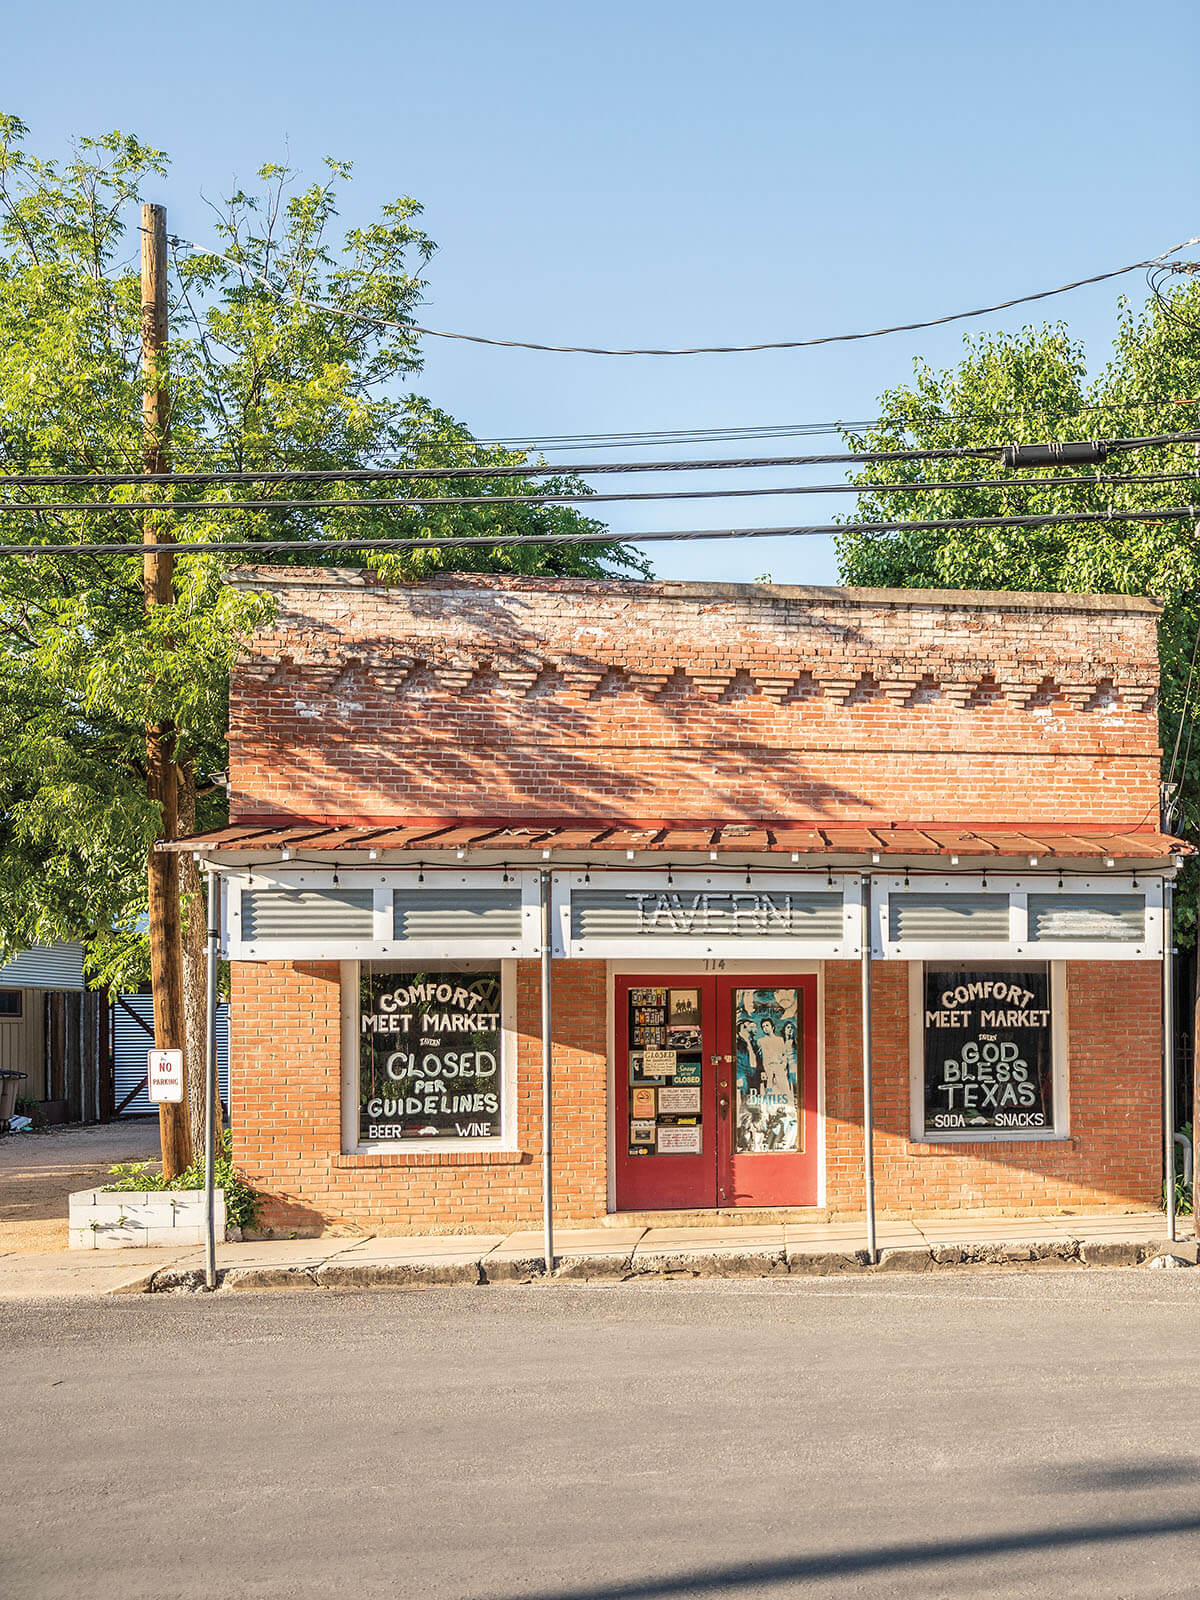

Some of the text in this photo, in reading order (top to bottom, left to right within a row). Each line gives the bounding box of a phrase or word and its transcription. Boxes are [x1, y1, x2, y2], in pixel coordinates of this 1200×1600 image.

[625, 893, 793, 935] TAVERN
[703, 959, 726, 971] 714
[380, 984, 482, 1012] COMFORT
[942, 981, 1035, 1008] COMFORT
[362, 1013, 500, 1033] MEET MARKET
[925, 1009, 1050, 1028] MEET MARKET
[645, 1051, 675, 1059] CLOSED
[961, 1041, 1020, 1064] GOD
[159, 1062, 171, 1072] NO
[387, 1051, 497, 1081] CLOSED
[943, 1059, 1028, 1083] BLESS
[414, 1079, 448, 1094] PER
[673, 1076, 700, 1084] CLOSED
[367, 1093, 499, 1118] GUIDELINES
[749, 1087, 789, 1106] BEATLES
[938, 1081, 1036, 1111] TEXAS
[935, 1113, 966, 1128] SODA
[994, 1112, 1044, 1127] SNACKS
[368, 1124, 402, 1139] BEER
[455, 1122, 491, 1137] WINE
